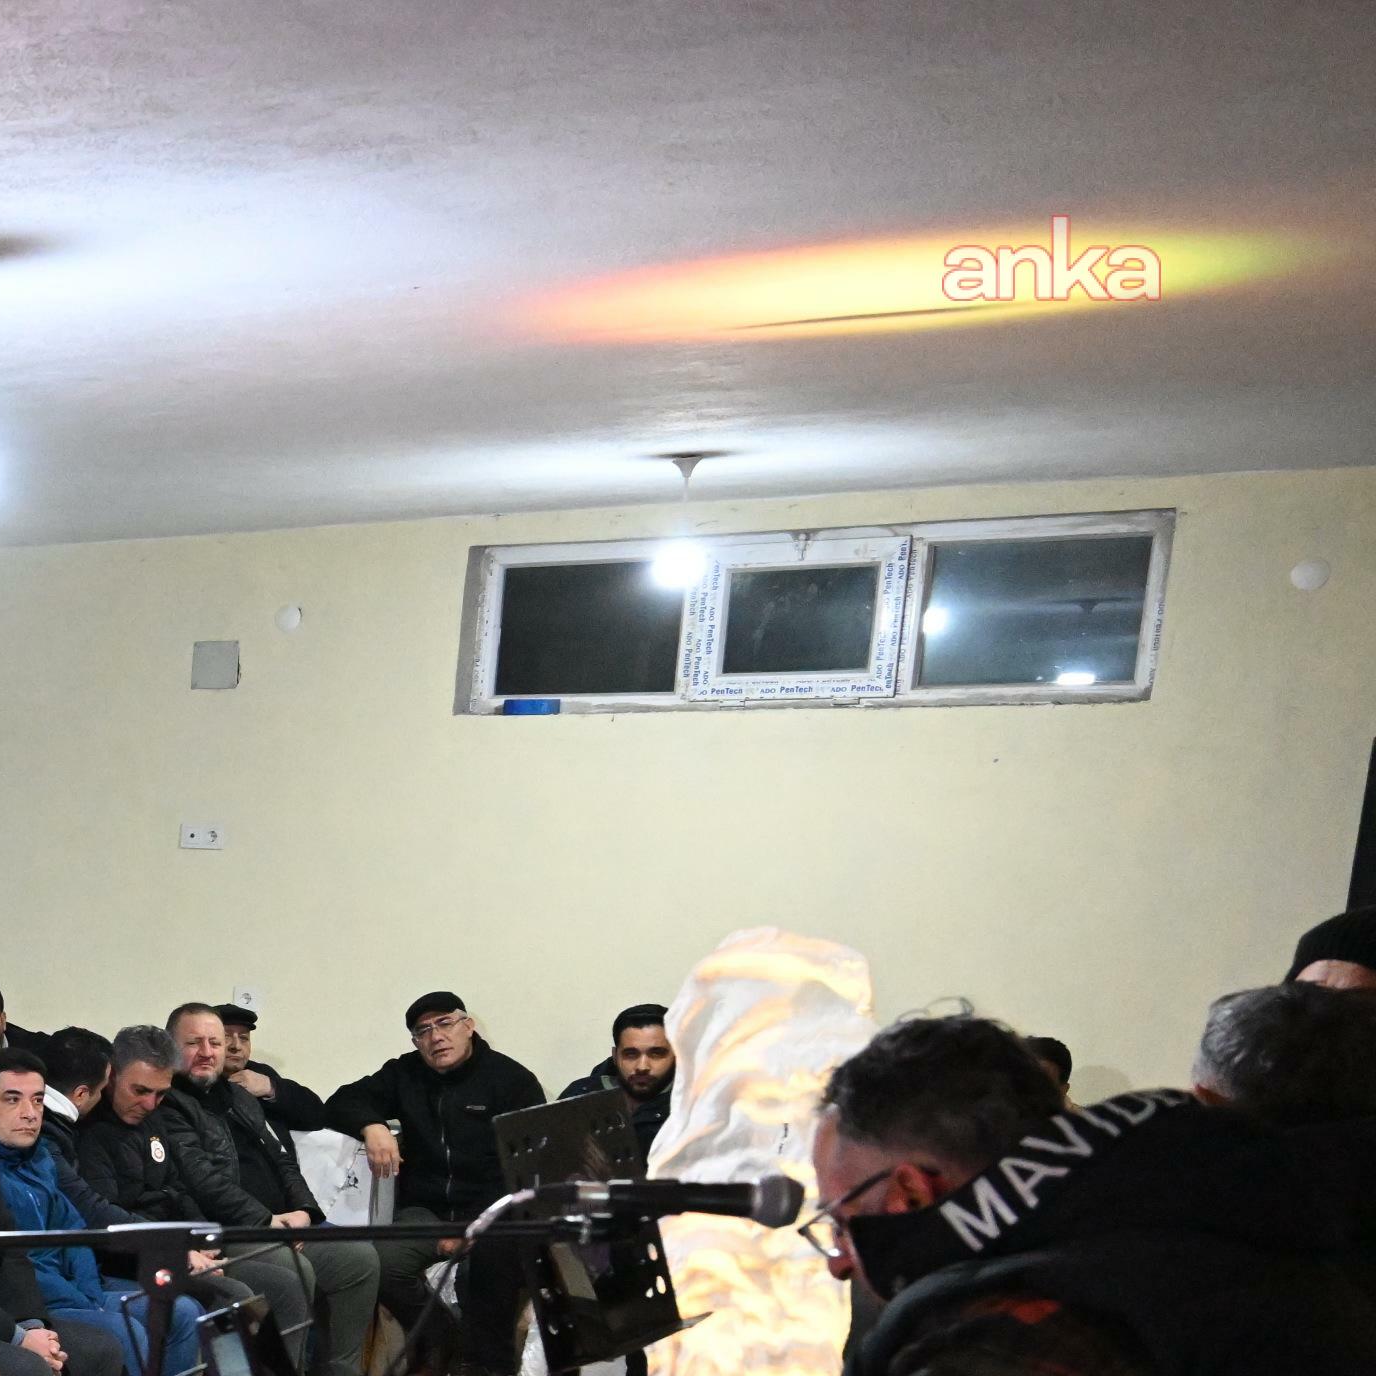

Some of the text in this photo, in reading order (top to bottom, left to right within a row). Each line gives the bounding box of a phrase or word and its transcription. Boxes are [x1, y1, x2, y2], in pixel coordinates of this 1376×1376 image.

[884, 562, 894, 595] PenTech
[706, 624, 715, 655] PenTech
[683, 649, 693, 678] PenTech
[693, 656, 702, 686] PenTech
[780, 685, 813, 694] PenTech
